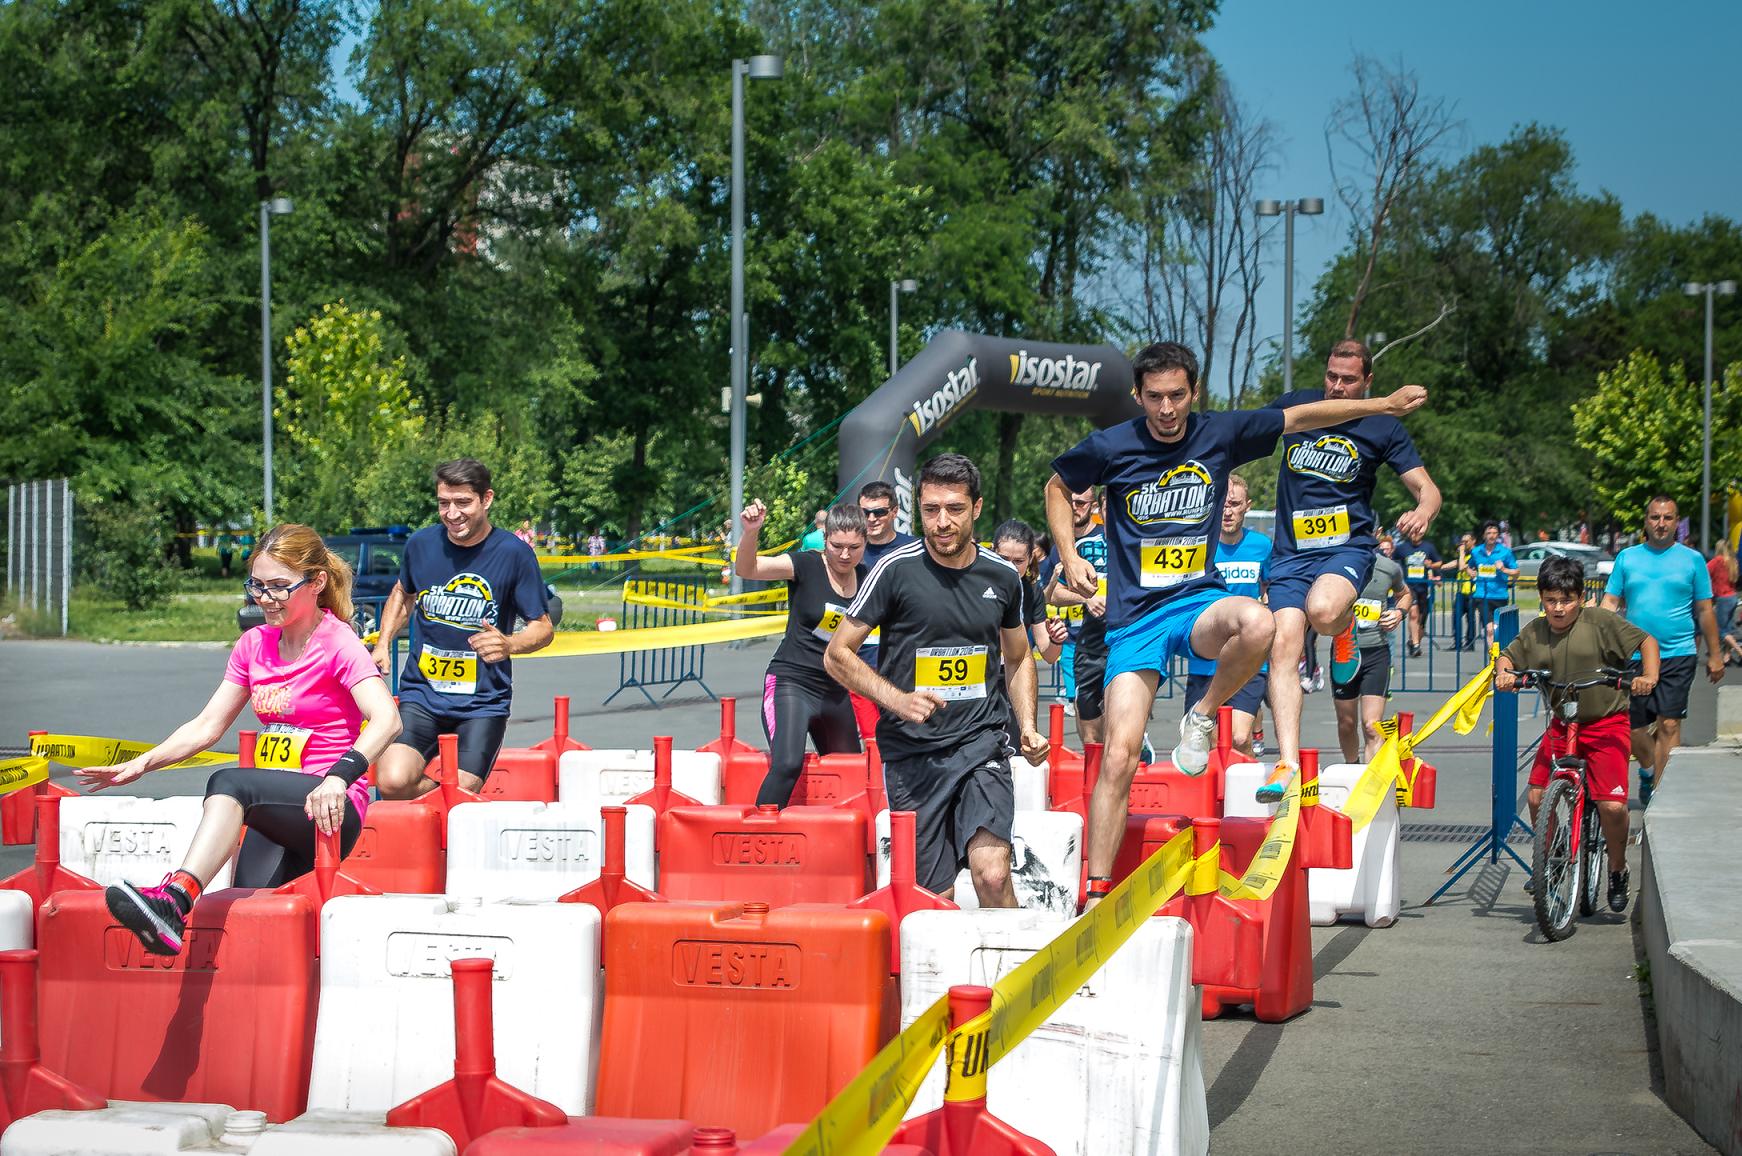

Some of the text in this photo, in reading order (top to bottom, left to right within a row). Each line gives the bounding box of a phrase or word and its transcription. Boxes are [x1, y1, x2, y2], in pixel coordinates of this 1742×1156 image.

[1013, 350, 1101, 389] isostar
[911, 357, 977, 435] isostar
[1141, 482, 1159, 494] 5K
[893, 467, 912, 536] star
[1304, 515, 1337, 535] 391
[1154, 548, 1197, 569] 437
[1224, 566, 1256, 579] didas
[430, 585, 445, 595] 5K
[829, 614, 840, 629] 5
[428, 657, 465, 677] 375
[938, 659, 968, 682] 59
[260, 737, 291, 762] 473
[93, 826, 171, 853] VESTA
[507, 832, 589, 861] VESTA
[720, 836, 800, 864] VESTA
[681, 944, 791, 987] VESTA
